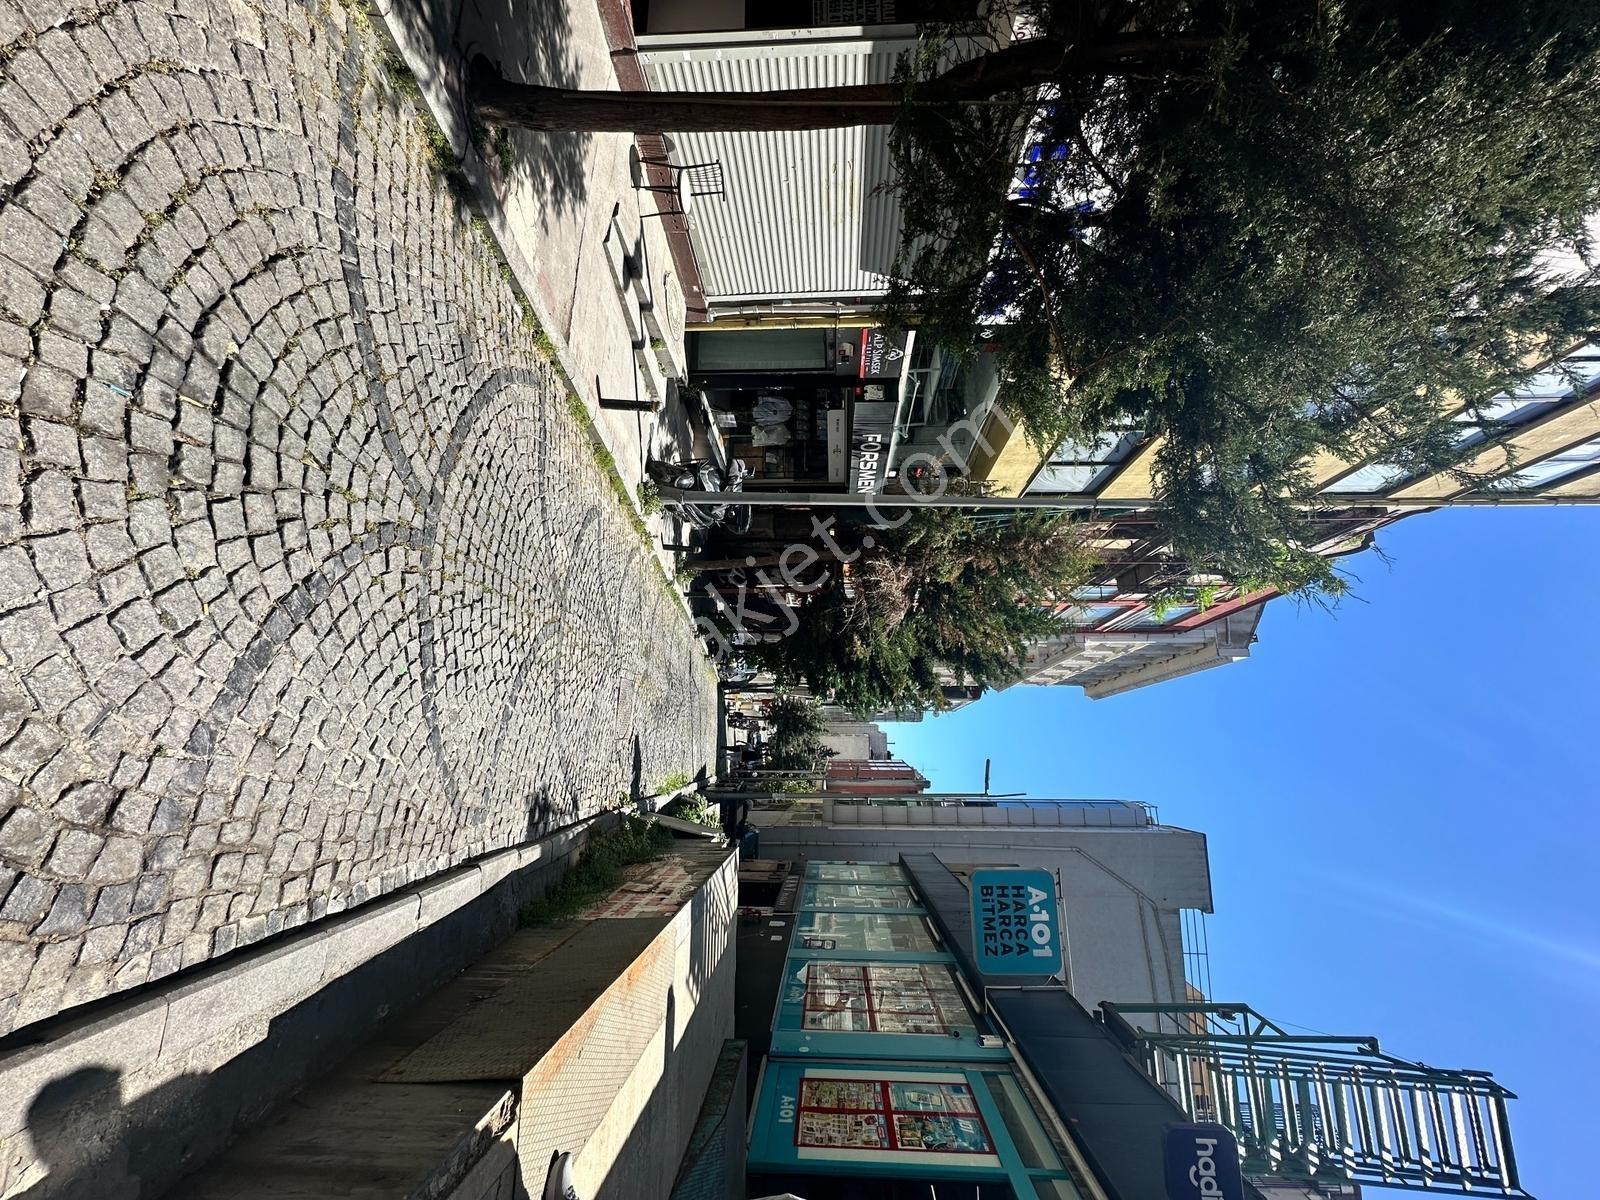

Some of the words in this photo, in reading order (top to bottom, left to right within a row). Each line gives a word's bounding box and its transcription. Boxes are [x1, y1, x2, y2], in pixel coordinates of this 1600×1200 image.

[874, 334, 884, 348] ALP
[857, 434, 881, 493] FORSMEN
[996, 886, 1014, 956] HARCA
[1011, 886, 1030, 956] HARCA
